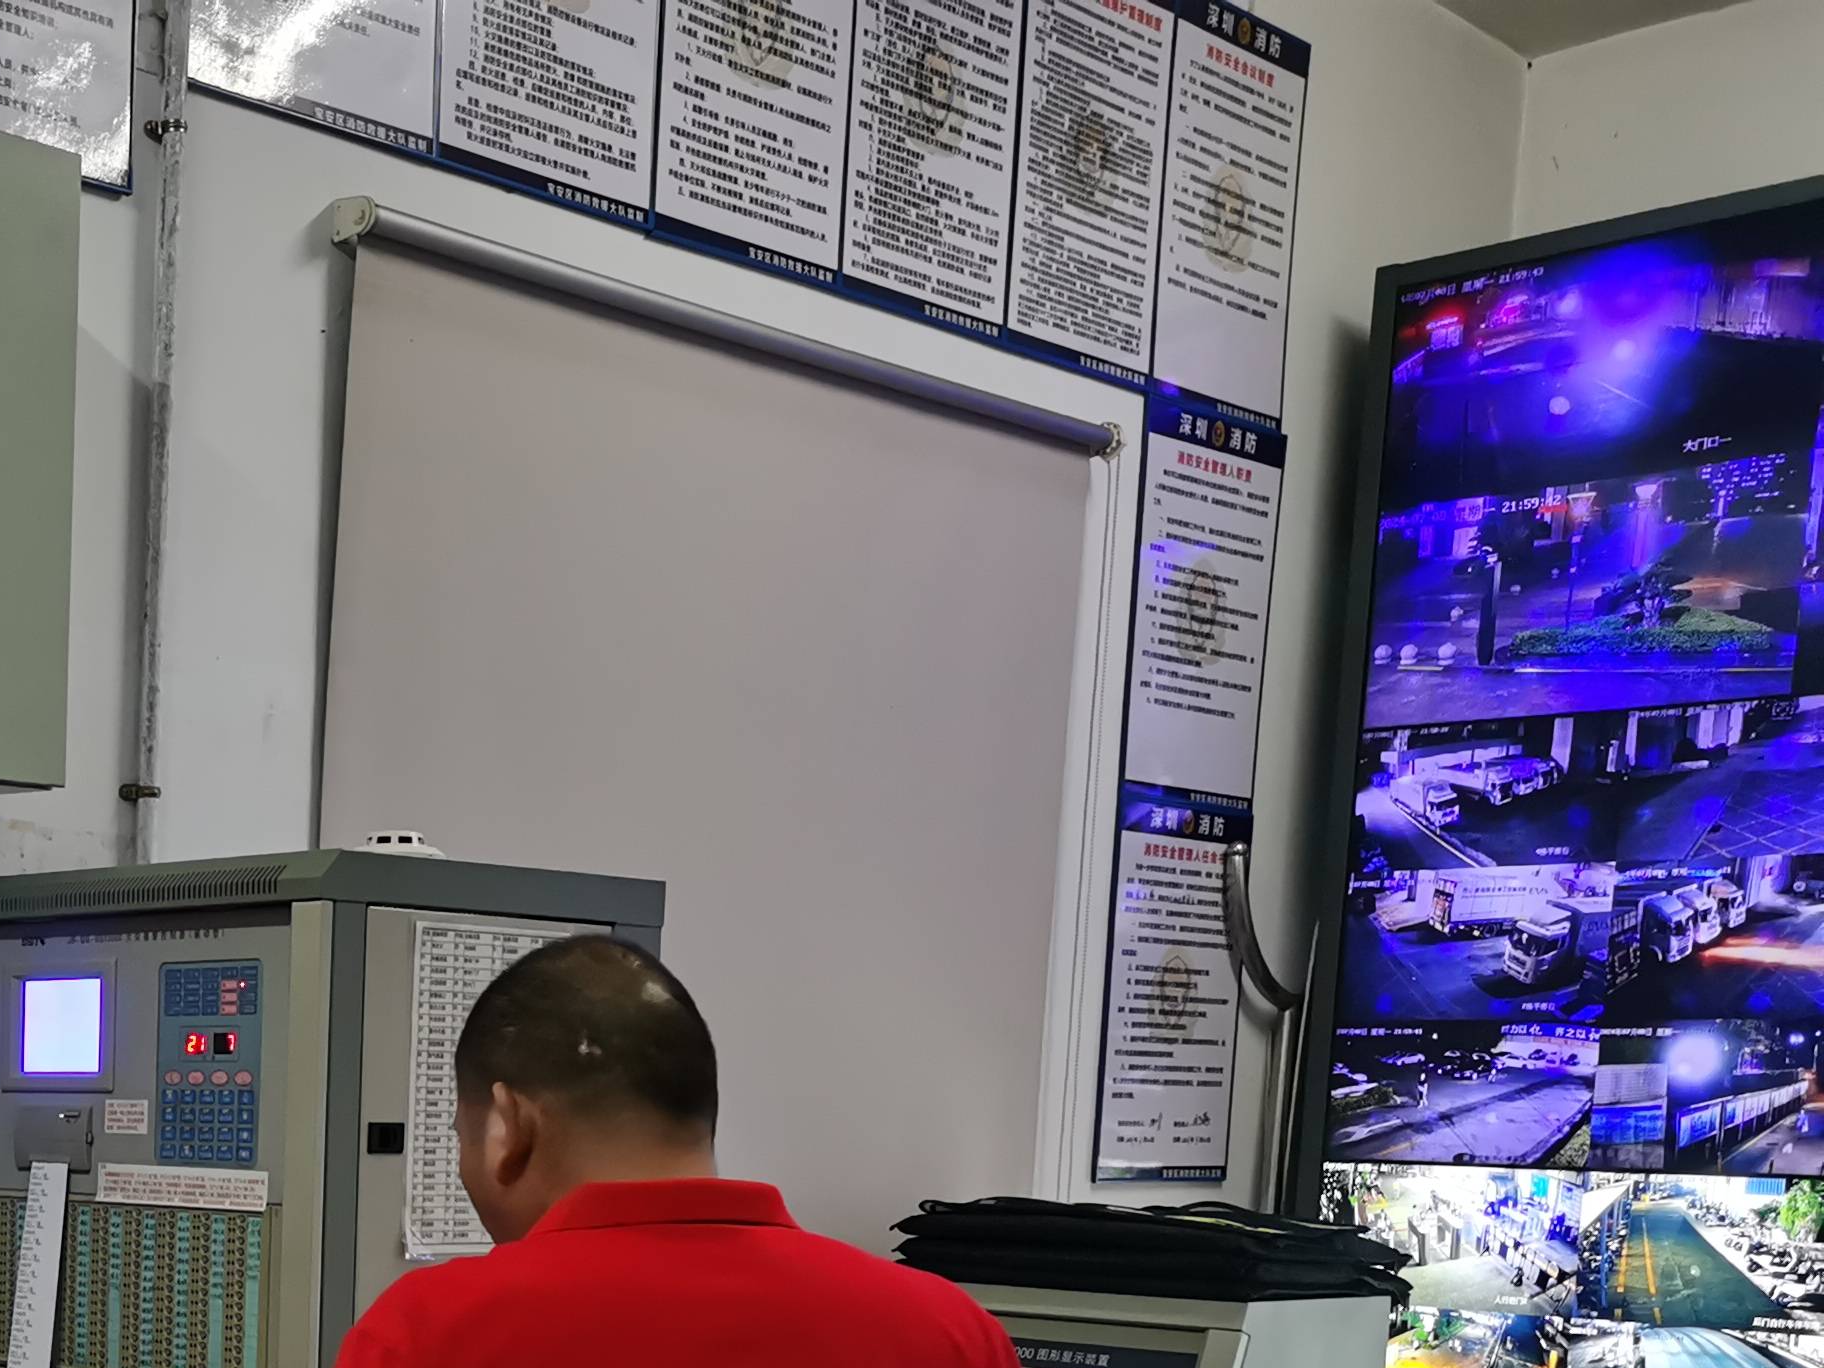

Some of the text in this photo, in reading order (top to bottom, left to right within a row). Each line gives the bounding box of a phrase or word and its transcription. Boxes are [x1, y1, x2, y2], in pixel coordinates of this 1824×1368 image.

[1207, 3, 1282, 58] 深圳 消防
[1179, 413, 1257, 454] 深圳 消防
[1150, 806, 1225, 837] 深圳 消防
[185, 1033, 237, 1054] 21 7
[1036, 1347, 1111, 1368] 图形显示装置
